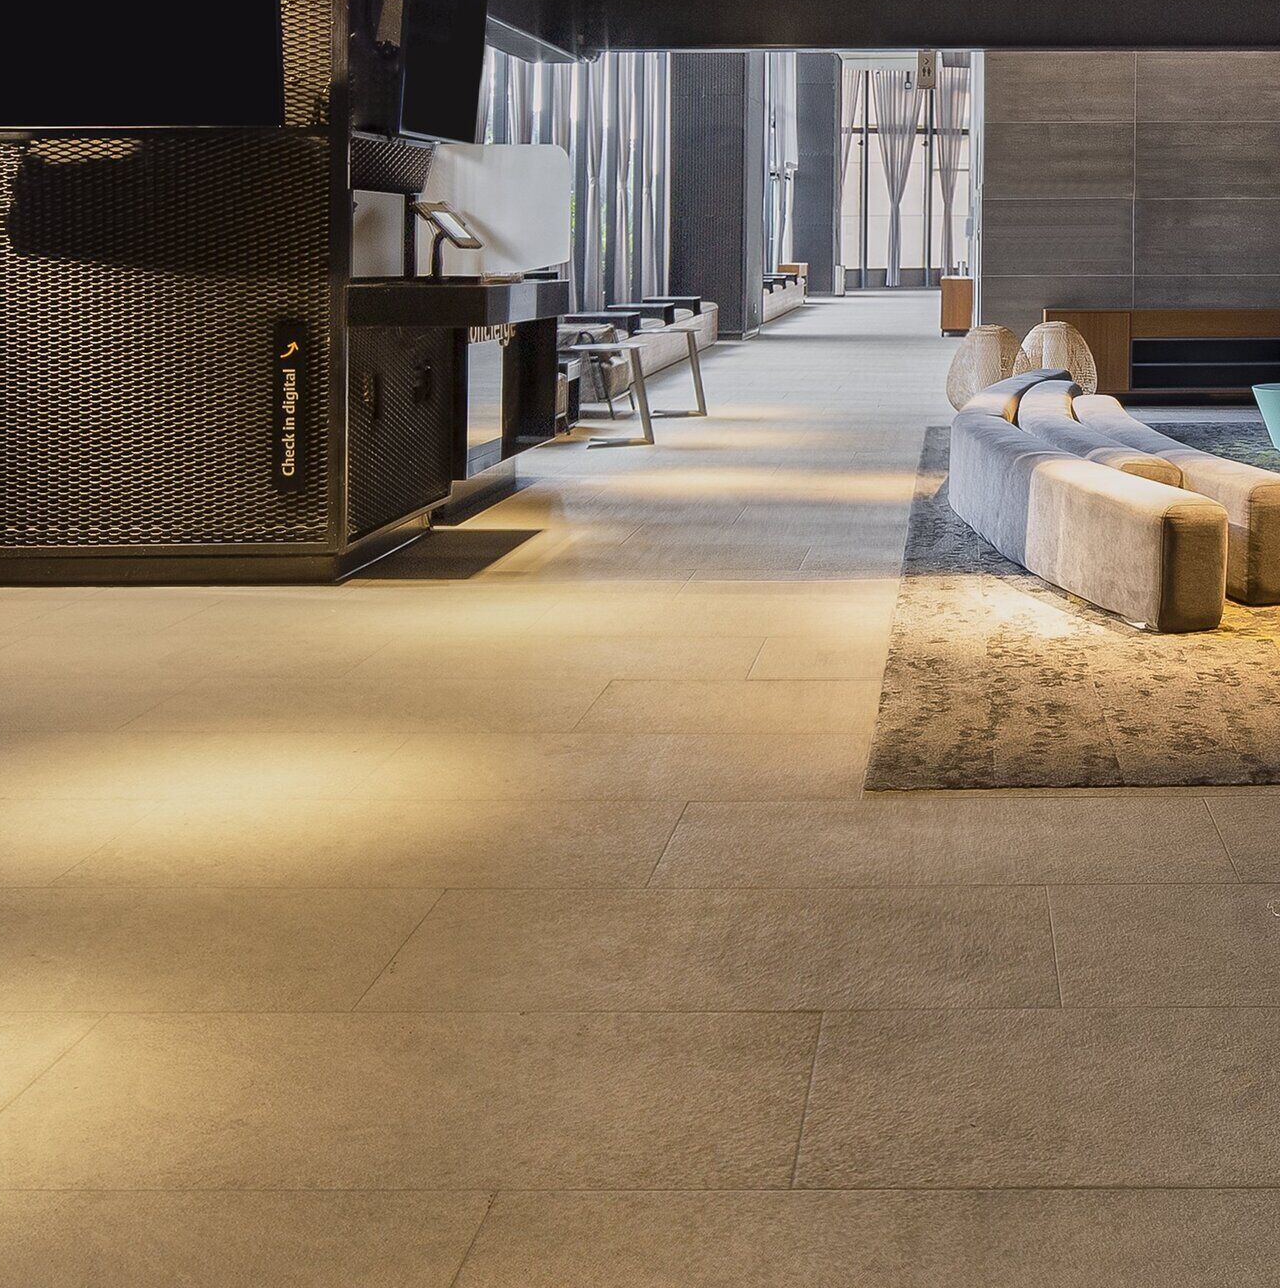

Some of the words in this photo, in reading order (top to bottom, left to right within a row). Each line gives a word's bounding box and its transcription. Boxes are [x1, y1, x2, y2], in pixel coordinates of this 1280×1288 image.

[469, 323, 516, 346] oncierge
[282, 368, 299, 415] digital
[282, 416, 295, 430] in
[282, 434, 295, 477] Check
